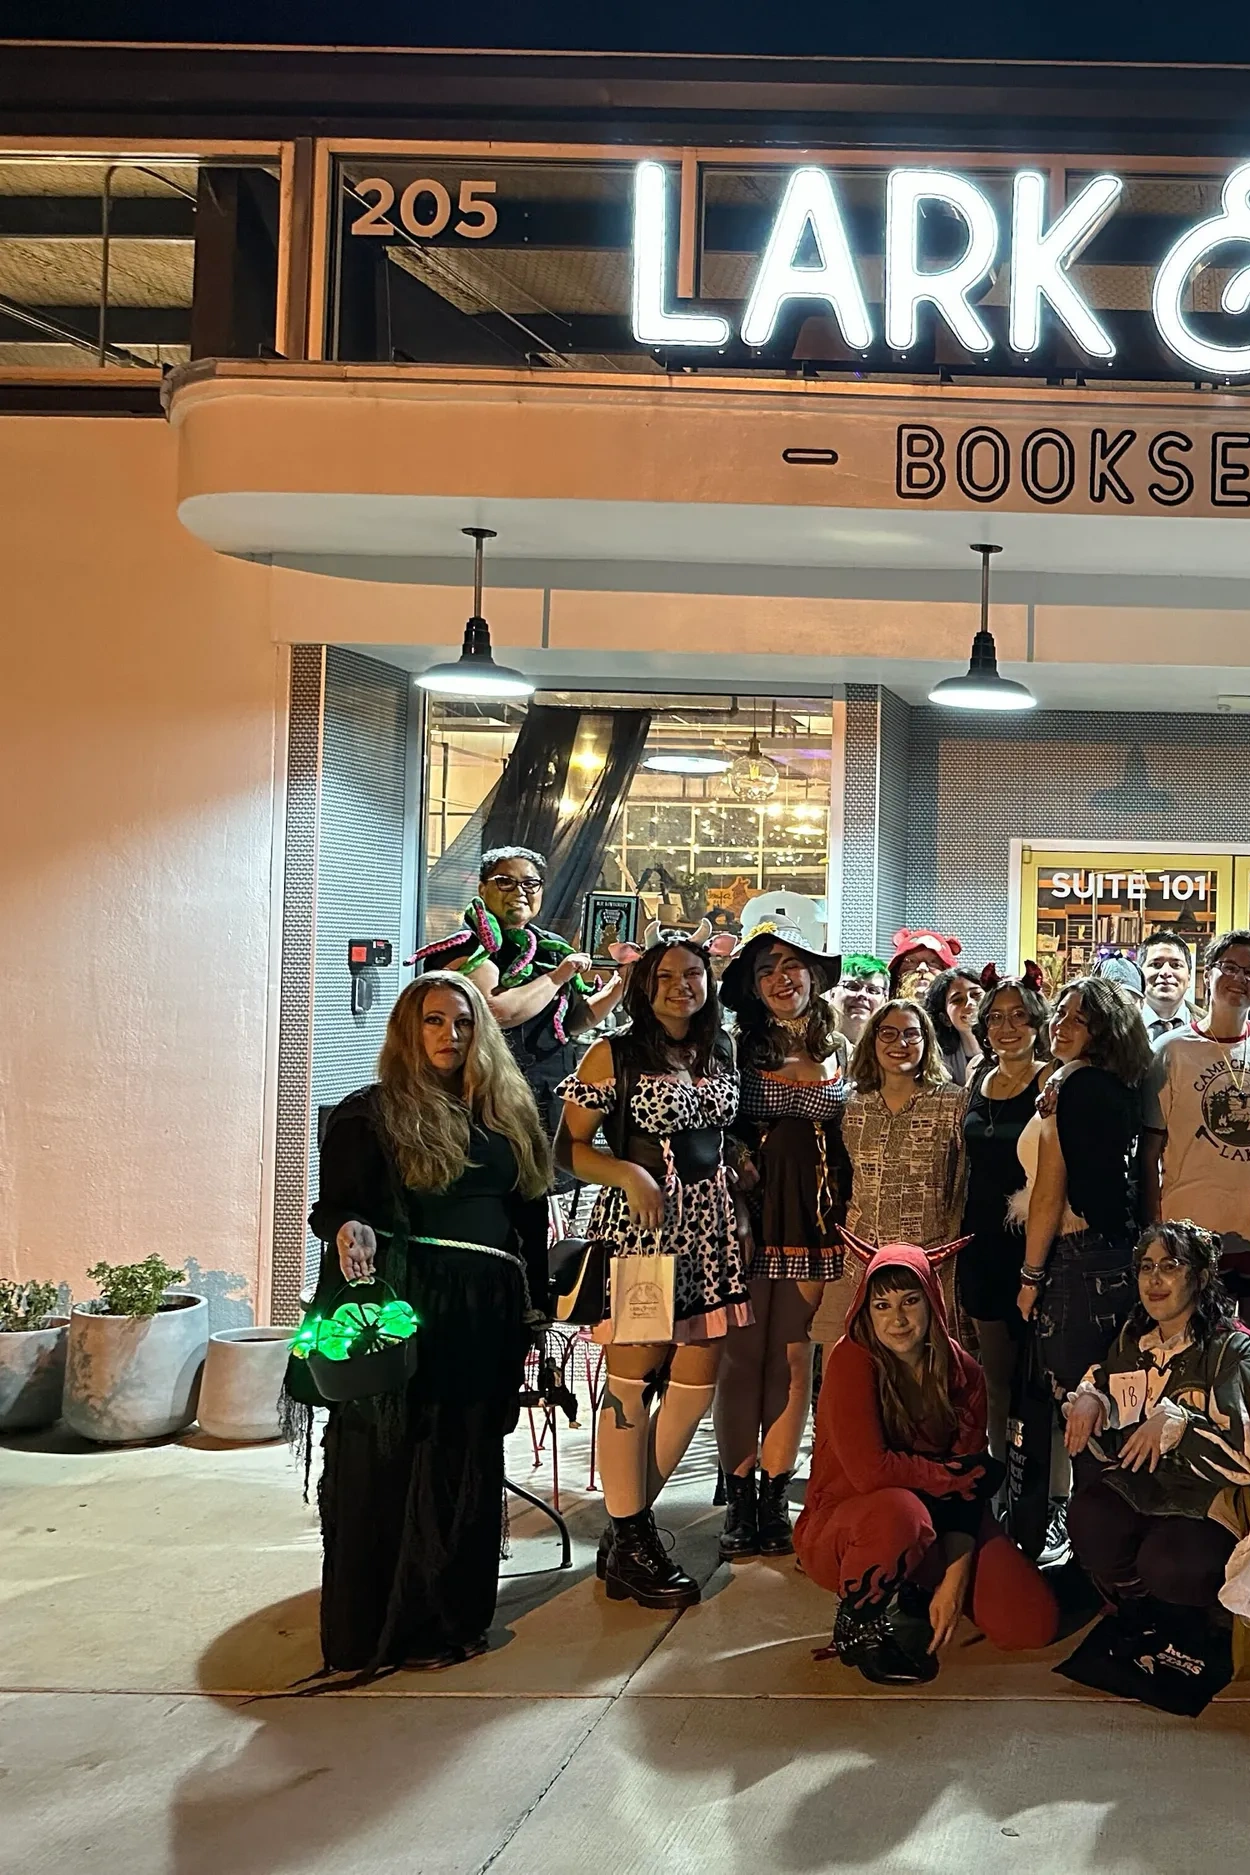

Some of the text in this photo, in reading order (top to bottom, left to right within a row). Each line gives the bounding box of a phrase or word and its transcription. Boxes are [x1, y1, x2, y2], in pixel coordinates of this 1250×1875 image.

[351, 178, 499, 238] 205
[630, 159, 1124, 359] LARK
[1051, 872, 1206, 901] SUITE 101
[1193, 1060, 1227, 1092] CAMP
[1122, 1385, 1138, 1407] 18
